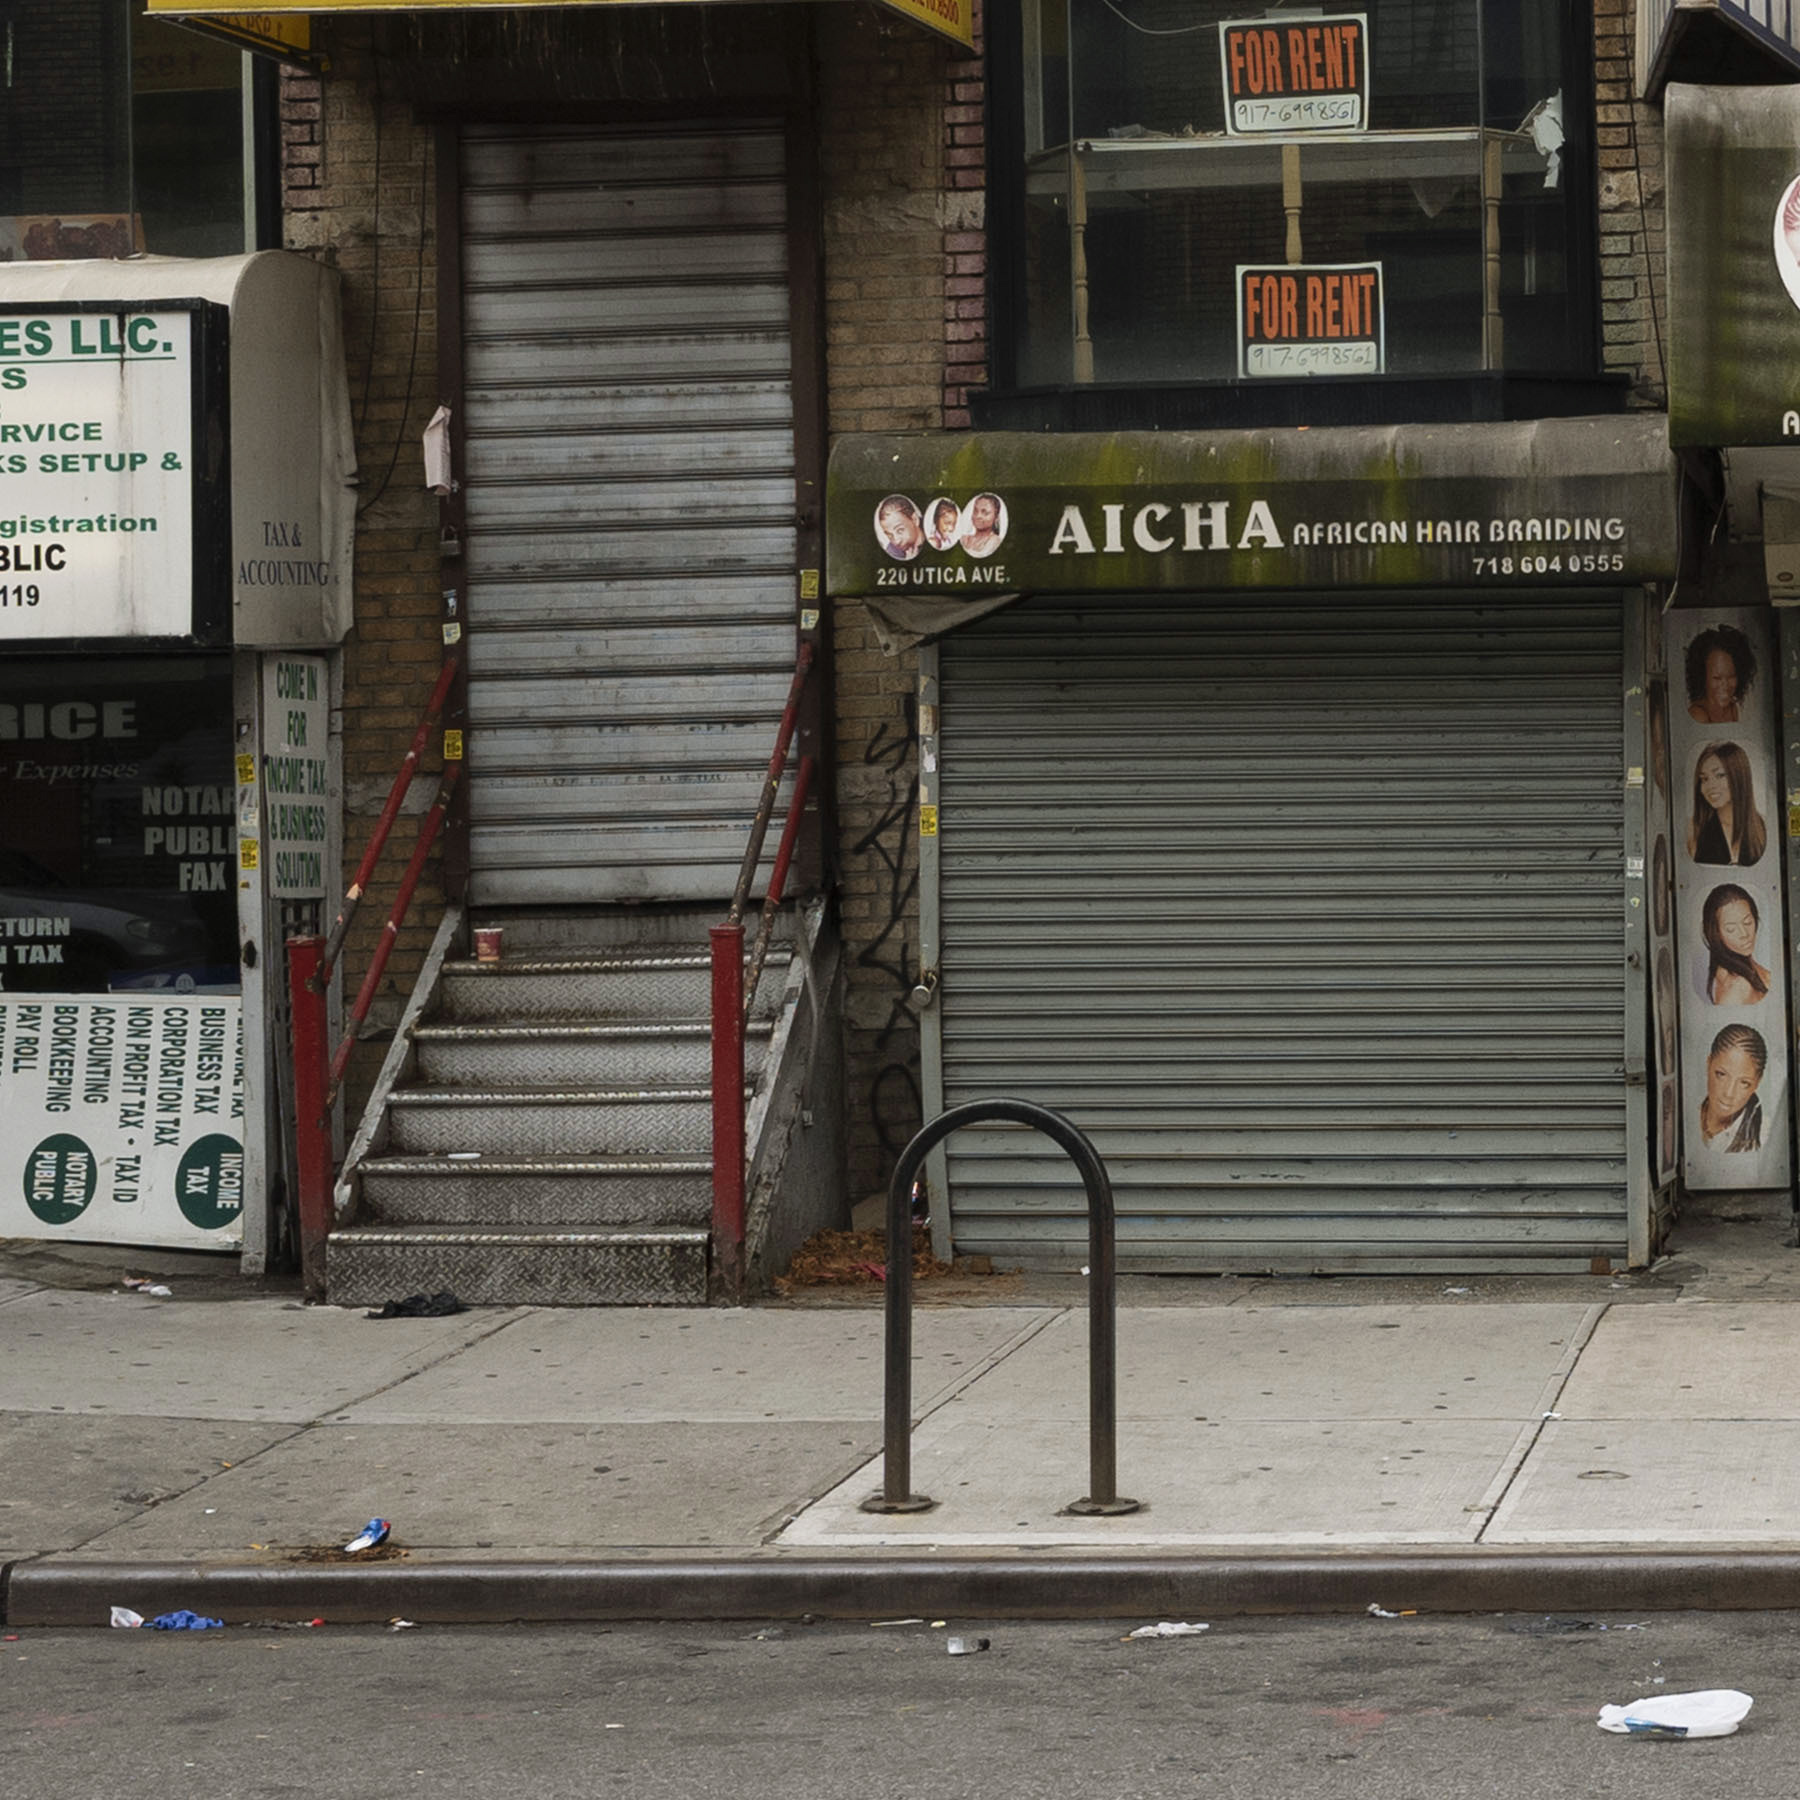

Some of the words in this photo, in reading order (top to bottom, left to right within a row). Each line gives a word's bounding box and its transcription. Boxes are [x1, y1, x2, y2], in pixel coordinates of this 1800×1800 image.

[1228, 29, 1286, 96] FOR
[1288, 25, 1359, 91] RENT
[1237, 99, 1355, 125] 917-6998561
[1246, 274, 1304, 340] FOR
[1307, 273, 1375, 339] RENT
[70, 318, 173, 354] LLC.
[39, 452, 148, 473] SETUP
[160, 451, 183, 471] &
[0, 513, 158, 539] gistration
[263, 521, 290, 547] TAX
[1048, 499, 1286, 555] AICHA
[1293, 521, 1409, 545] AFRICAN
[1415, 518, 1482, 544] HAIR
[1489, 516, 1626, 542] BRAIDING
[238, 560, 330, 586] ACCOUNTING
[876, 567, 909, 586] 220
[913, 565, 967, 585] UTICA
[970, 563, 1012, 584] AVE.
[1473, 556, 1514, 575] 718
[1519, 555, 1562, 574] 604
[1568, 554, 1624, 574] 0555
[276, 662, 305, 700] COME
[307, 664, 318, 700] IN
[287, 710, 307, 747] FOR
[14, 758, 140, 786] Expenses
[267, 757, 305, 795] INCOME
[307, 758, 326, 796] TAX
[280, 805, 326, 841] BUSINESS
[179, 862, 227, 892] FAX
[276, 851, 322, 889] SOLUTION
[14, 944, 64, 964] TAX
[16, 1004, 42, 1032] PAY
[126, 1006, 153, 1039] NON
[13, 1036, 39, 1074] ROLL
[45, 1005, 79, 1113] BOOKKEEPING
[83, 1006, 116, 1104] ACCOUNTING
[157, 1007, 189, 1113] CORPORATION
[196, 1007, 226, 1082] BUSINESS
[122, 1043, 150, 1096] PROFIT
[118, 1102, 145, 1130] TAX
[194, 1086, 221, 1115] TAX
[153, 1117, 181, 1147] TAX
[32, 1151, 58, 1201] PUBLIC
[62, 1152, 89, 1207] NOTARY
[114, 1154, 141, 1184] TAX
[185, 1166, 210, 1195] TAX
[216, 1153, 243, 1209] INCOME
[112, 1187, 138, 1204] ID
